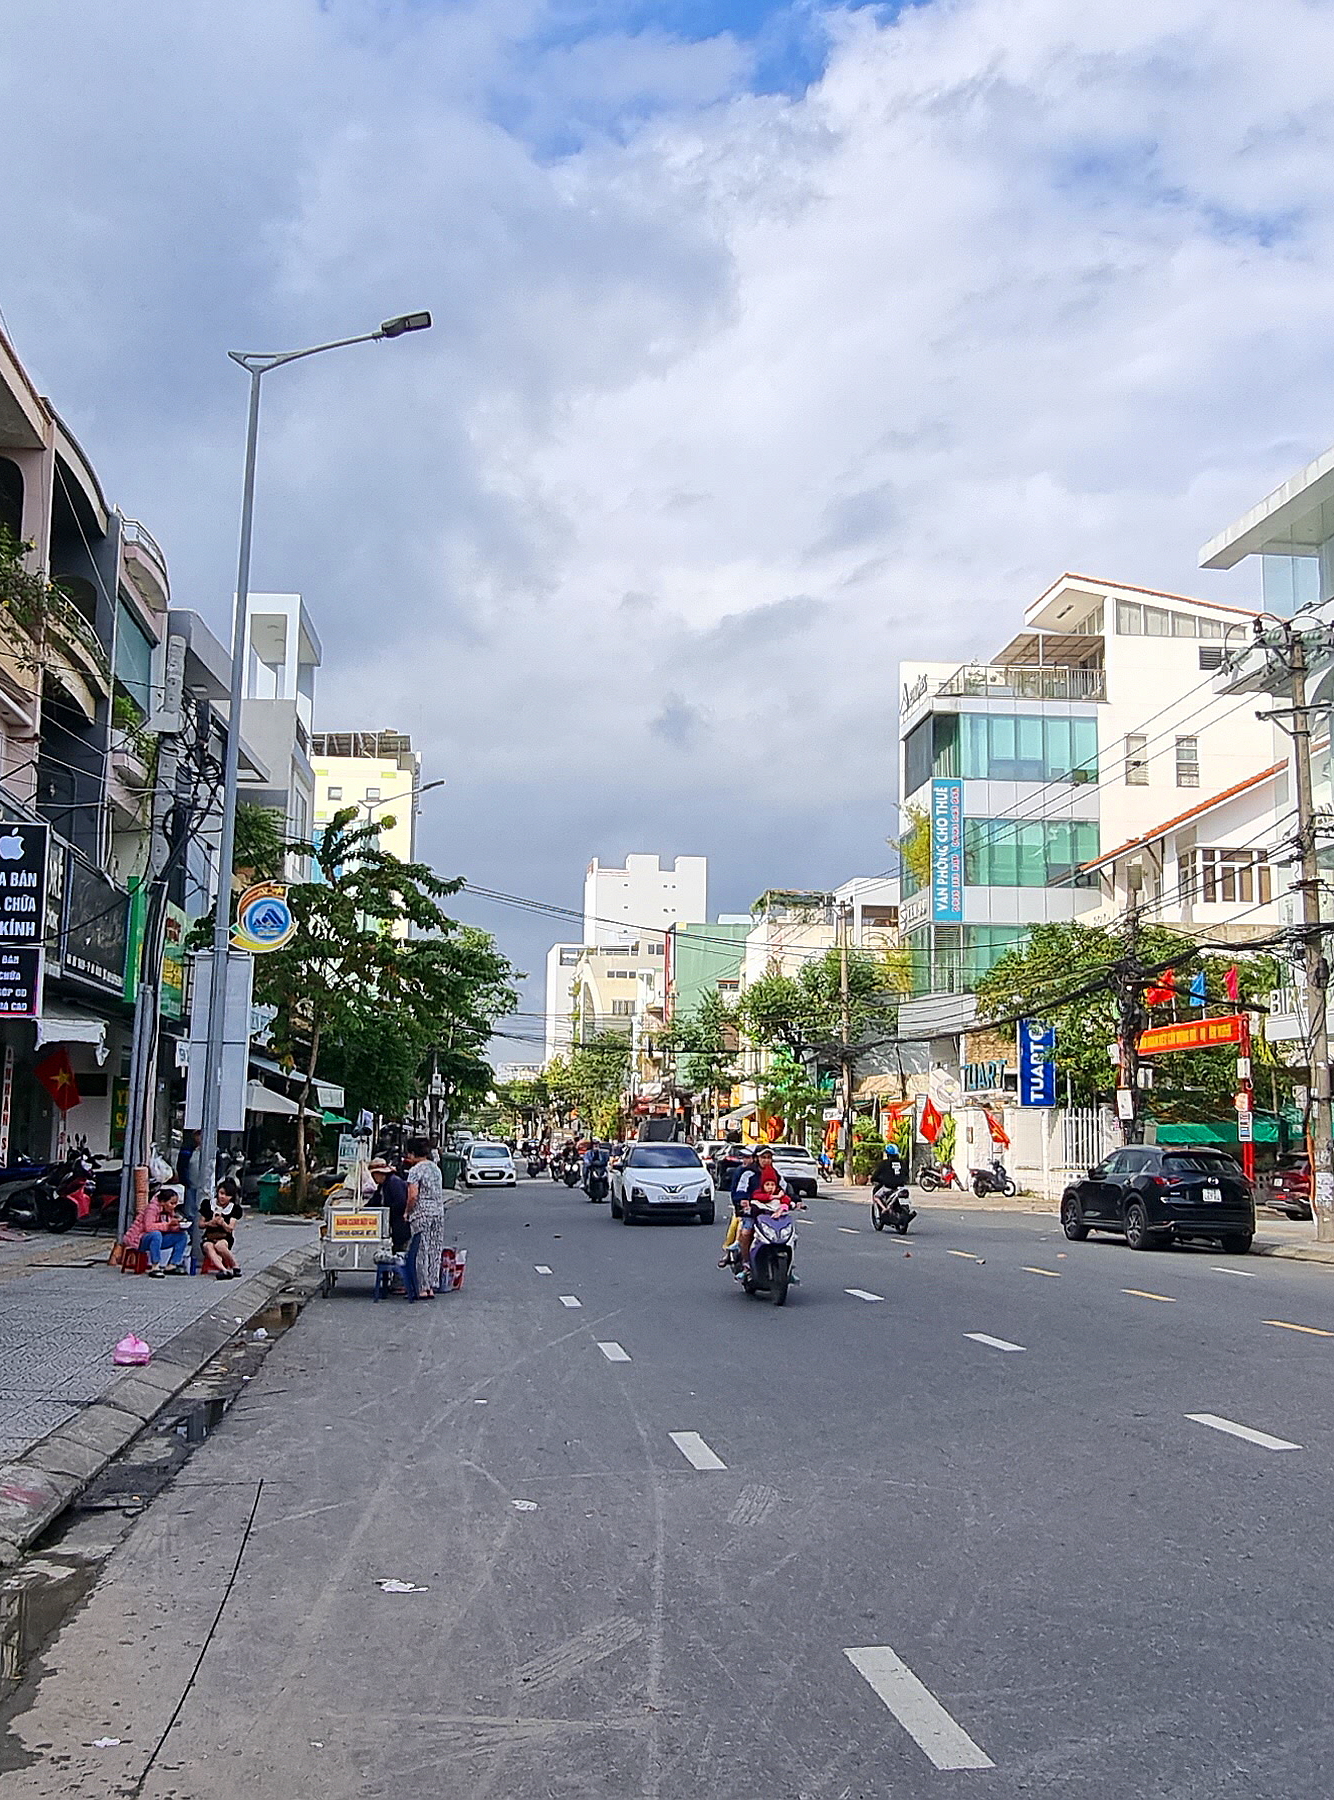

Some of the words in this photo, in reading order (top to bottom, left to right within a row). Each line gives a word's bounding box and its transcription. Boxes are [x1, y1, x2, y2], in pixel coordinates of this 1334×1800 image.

[935, 818, 948, 843] CHO
[10, 870, 37, 888] BÁN
[4, 894, 36, 912] CHỮA
[0, 918, 35, 936] KÍNH
[1270, 978, 1308, 1016] BIKE
